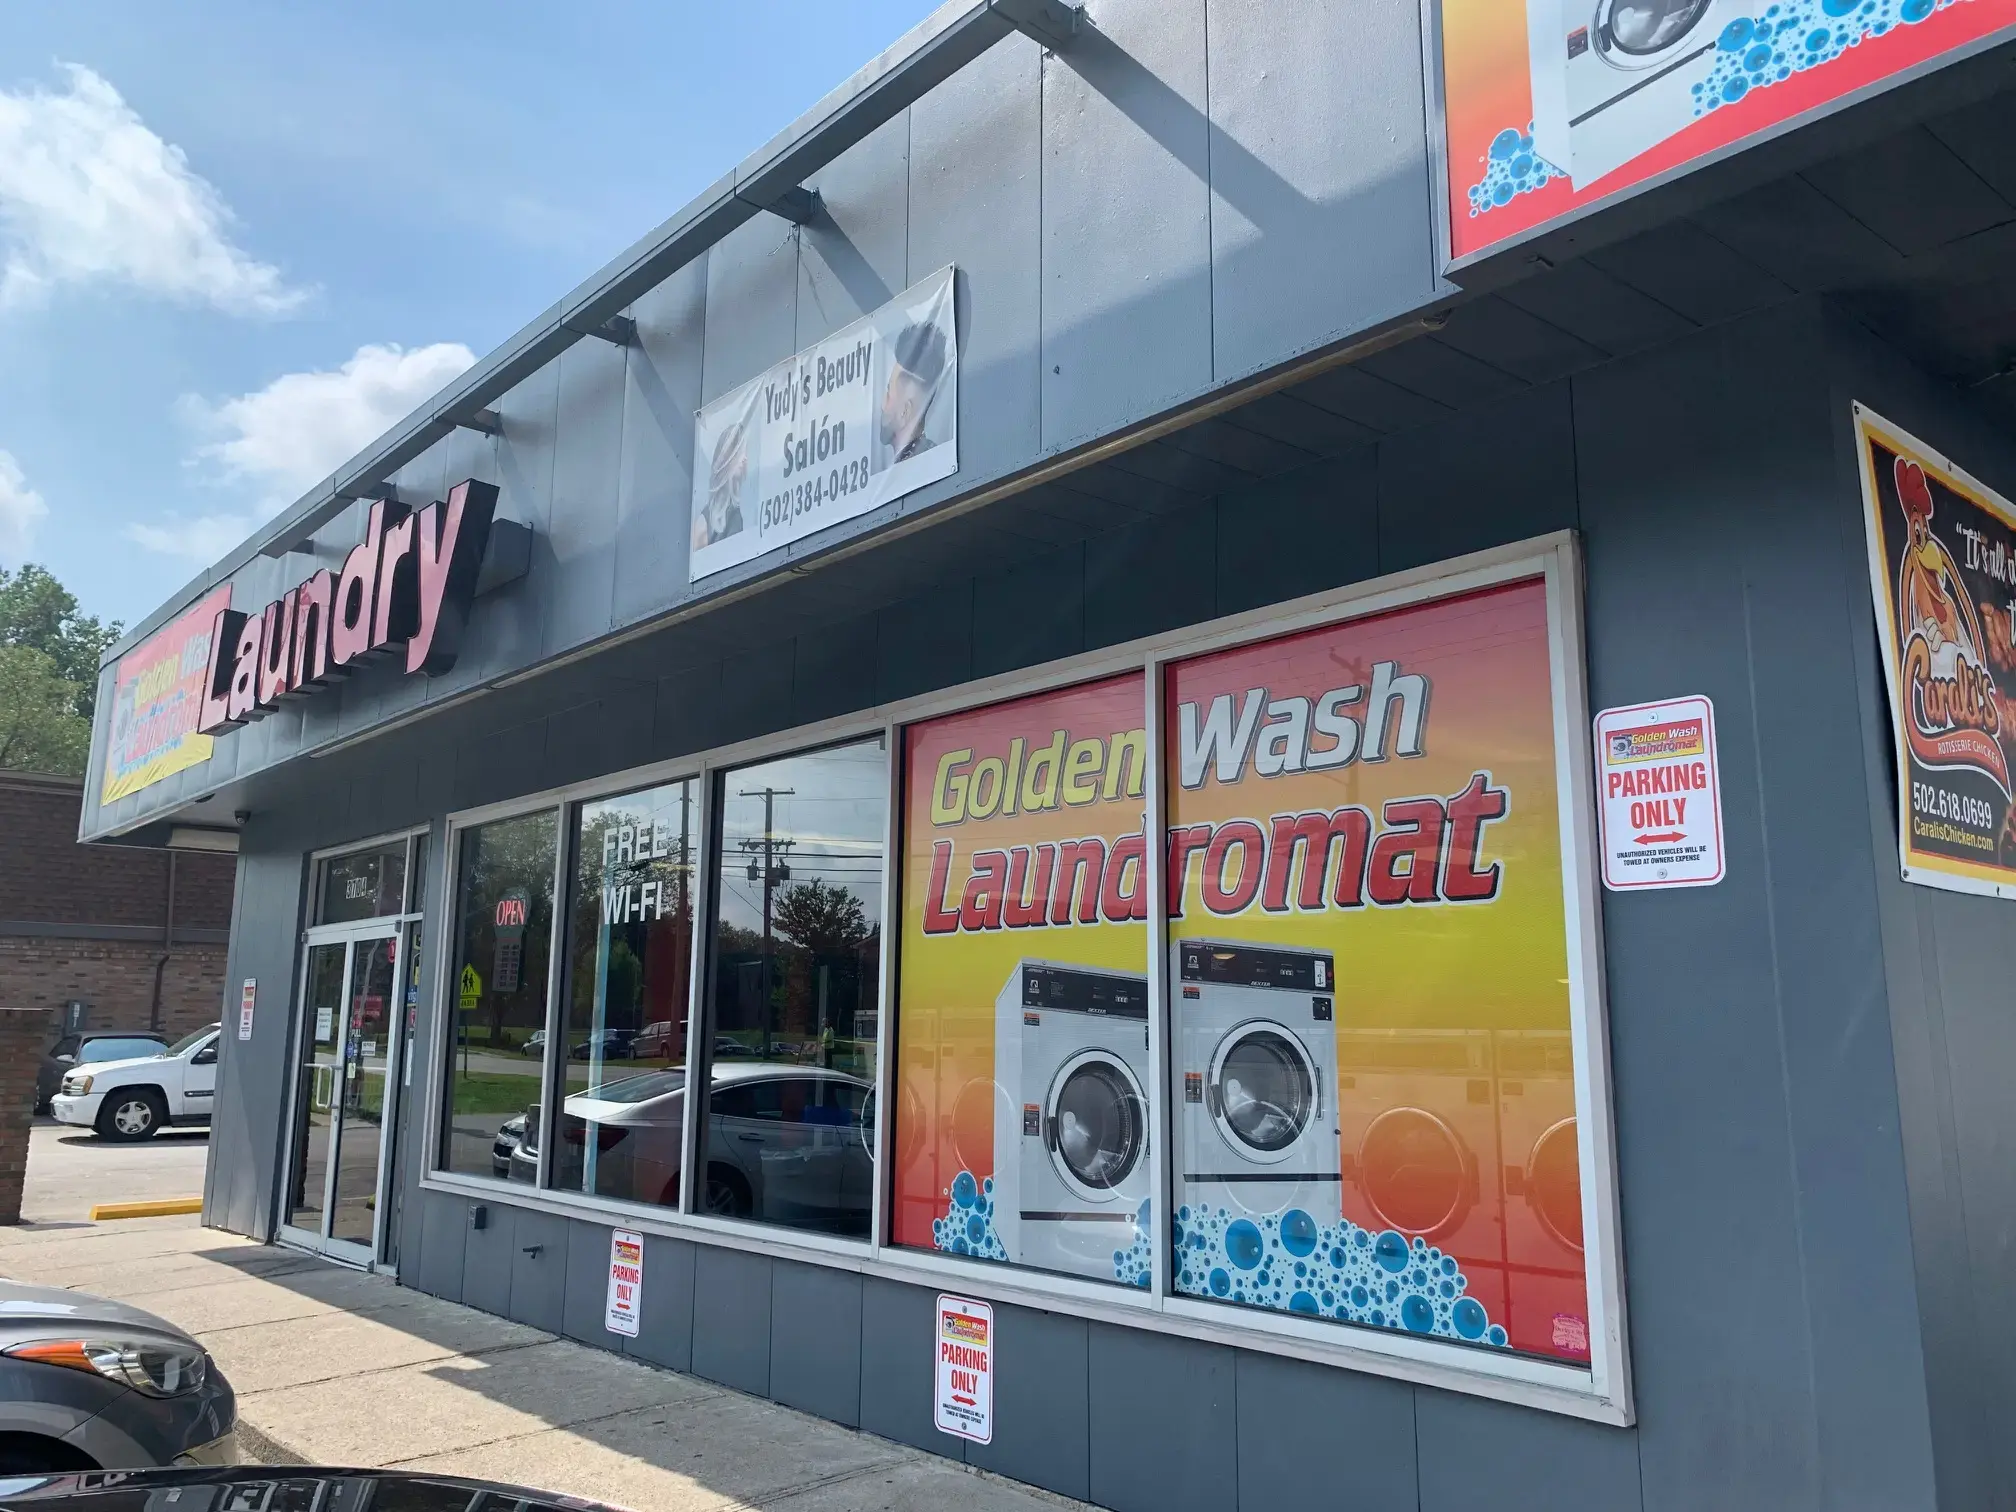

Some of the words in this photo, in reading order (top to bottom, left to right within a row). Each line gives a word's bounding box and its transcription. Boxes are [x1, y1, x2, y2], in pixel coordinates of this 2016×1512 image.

[765, 365, 811, 425] Yudy's
[816, 341, 872, 398] Beauty
[783, 415, 846, 478] Salón
[759, 456, 869, 538] (502)384-0428
[199, 478, 500, 737] Laundry
[1904, 633, 1999, 737] Carali's
[930, 726, 1146, 828] Golden
[1177, 660, 1432, 791] Wash
[1629, 739, 1698, 756] Laundromat
[1631, 731, 1667, 744] Golden
[1668, 726, 1698, 739] Wash
[1937, 739, 1971, 755] ROTISSERIE
[1973, 740, 2000, 769] CHICKEN
[1608, 761, 1707, 799] PARKING
[1630, 797, 1687, 829] ONLY
[1913, 781, 1992, 830] 502.618.0699
[602, 818, 669, 866] FREE
[1913, 815, 1994, 851] CaralisChicken.com
[922, 769, 1511, 935] Laundromat
[1616, 849, 1657, 859] UNAUTHORIZED
[1657, 847, 1684, 856] VEHICLES
[1684, 846, 1698, 854] WILL
[1623, 858, 1642, 866] TOWED
[1650, 856, 1675, 864] OWNERS
[1675, 854, 1701, 863] EXPENSE
[496, 900, 526, 926] OPEN
[602, 881, 663, 925] WI-FI
[612, 1264, 640, 1285] PARKING
[616, 1284, 633, 1302] ONLY
[941, 1342, 988, 1373] PARKING
[950, 1369, 978, 1395] ONLY
